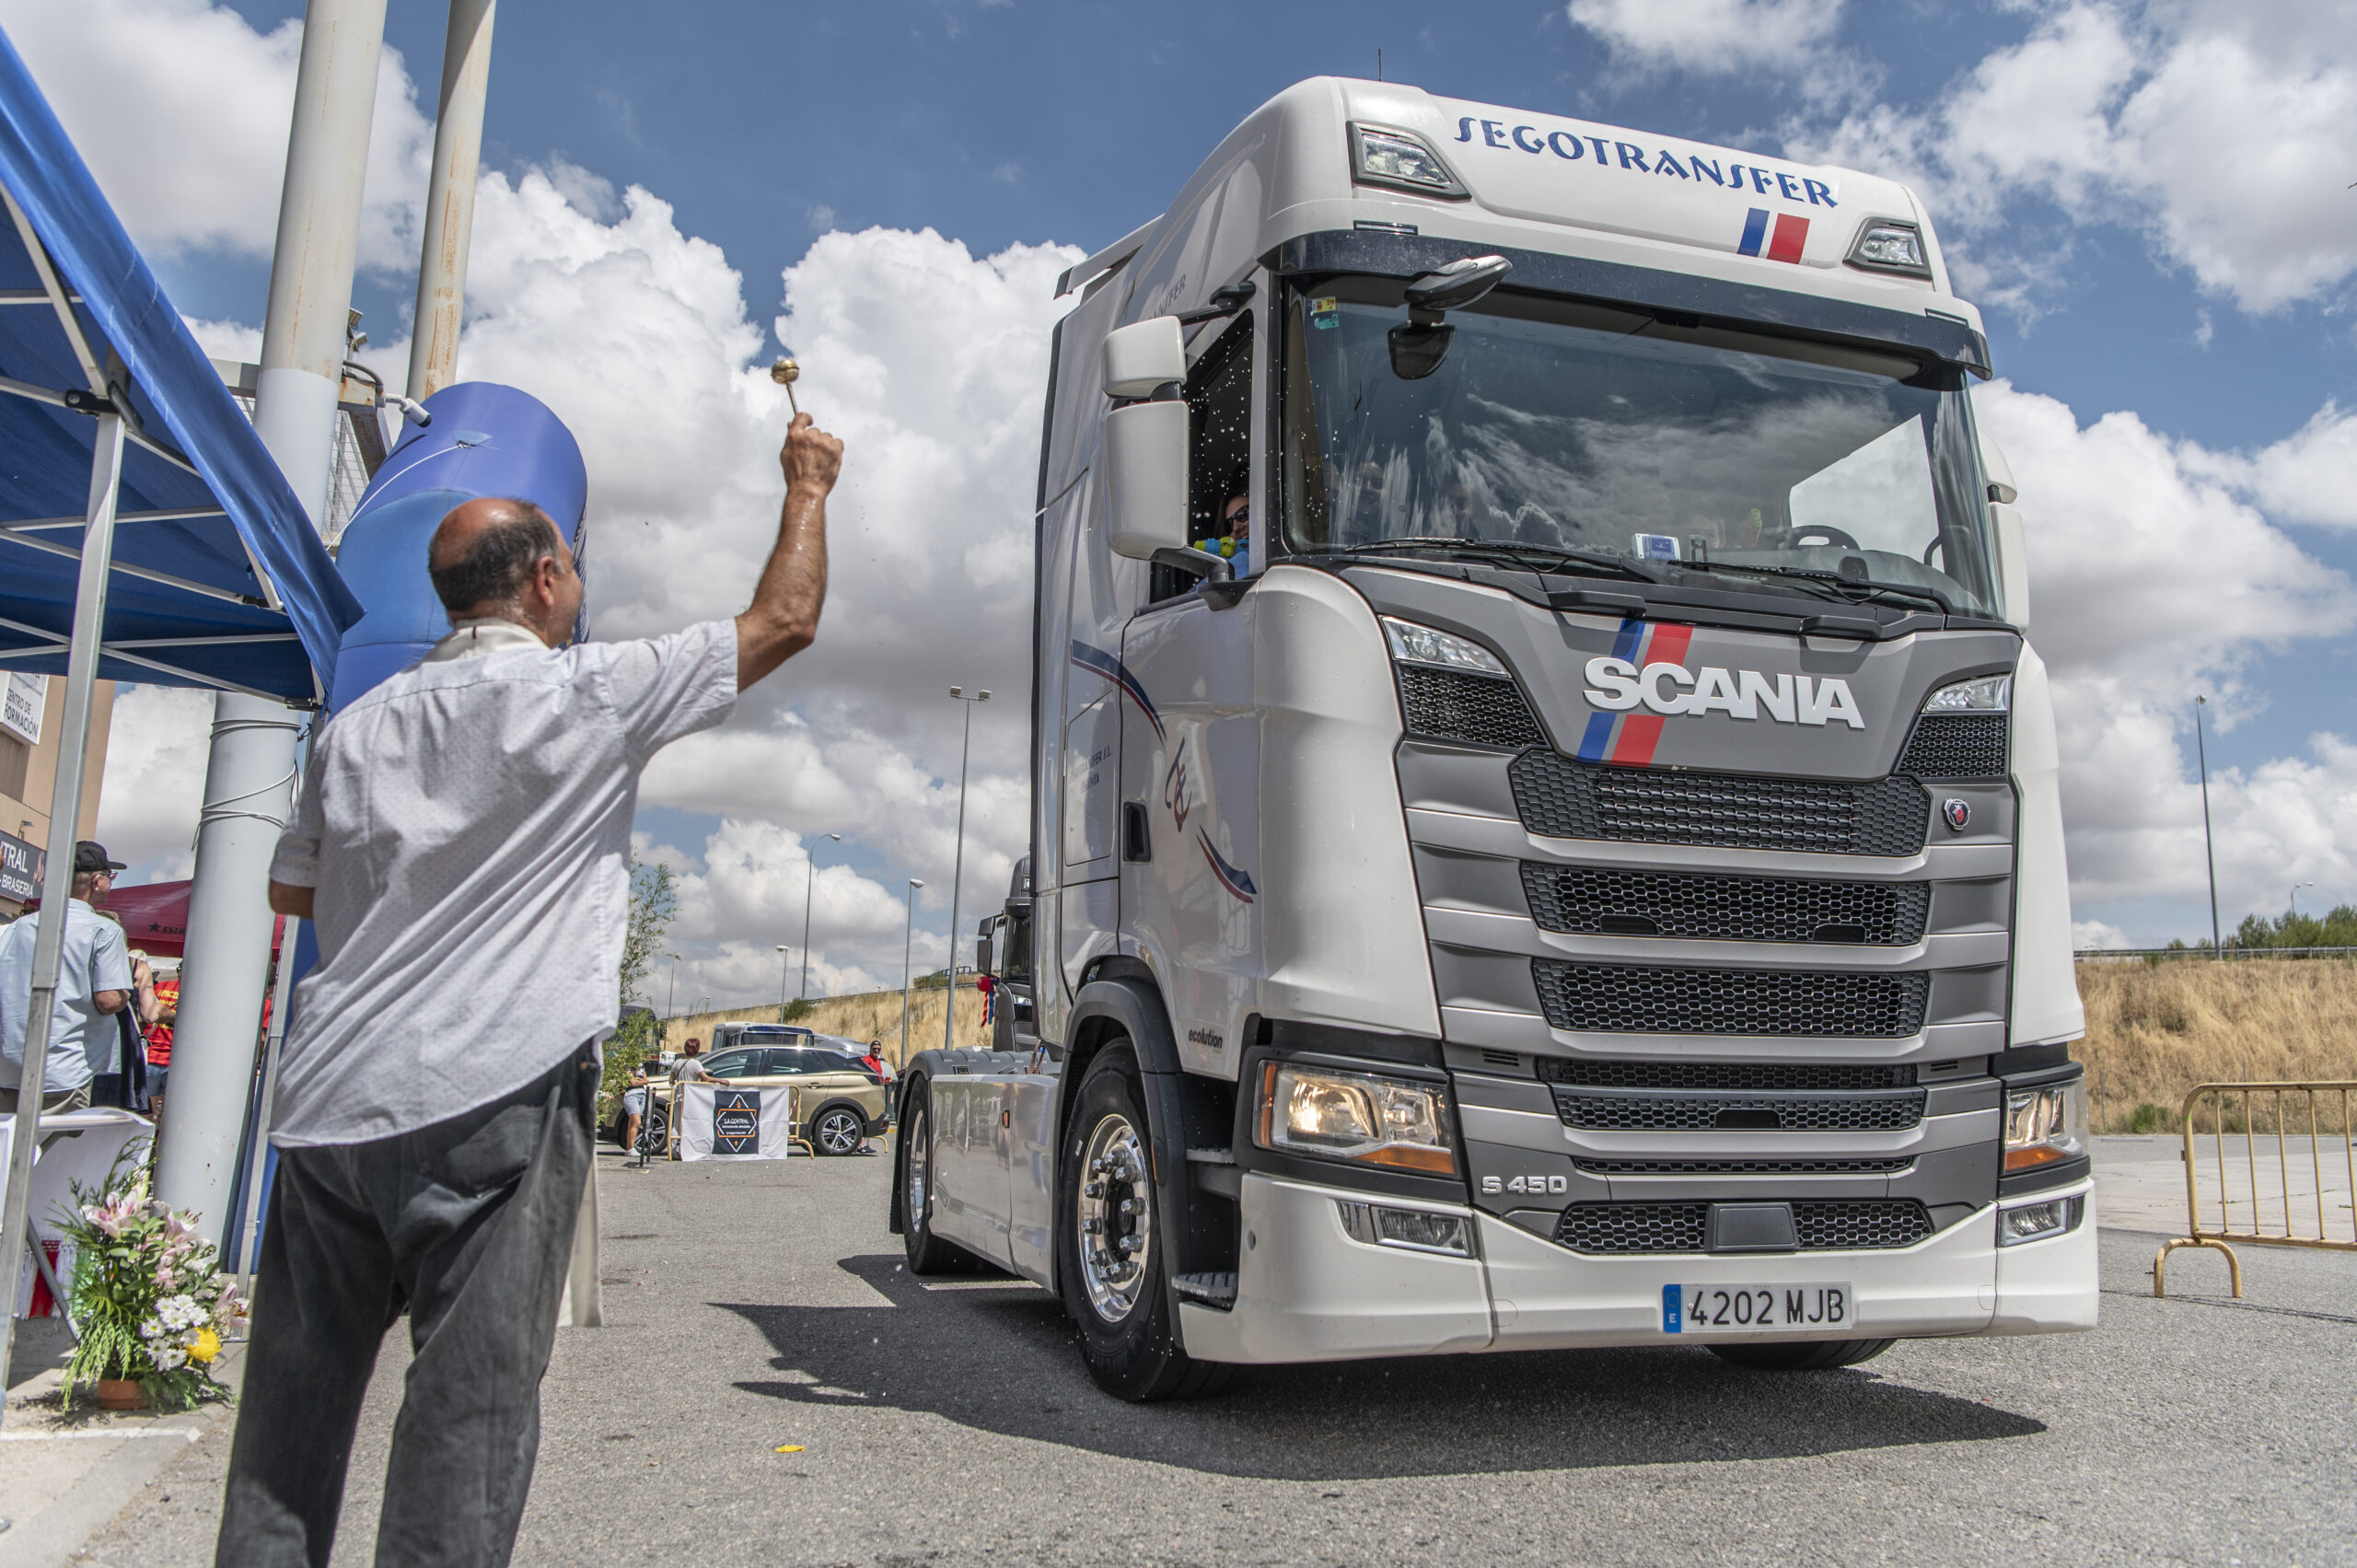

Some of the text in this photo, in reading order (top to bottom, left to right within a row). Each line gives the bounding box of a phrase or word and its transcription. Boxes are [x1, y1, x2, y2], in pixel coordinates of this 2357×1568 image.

[1455, 116, 1839, 208] SEGOTRANSFER
[1583, 656, 1866, 730] SCANIA
[25, 702, 31, 714] DE
[1189, 1028, 1223, 1050] ecolution
[1482, 1176, 1567, 1194] S 450
[1669, 1313, 1677, 1324] E
[1689, 1290, 1844, 1326] 4202 MJB
